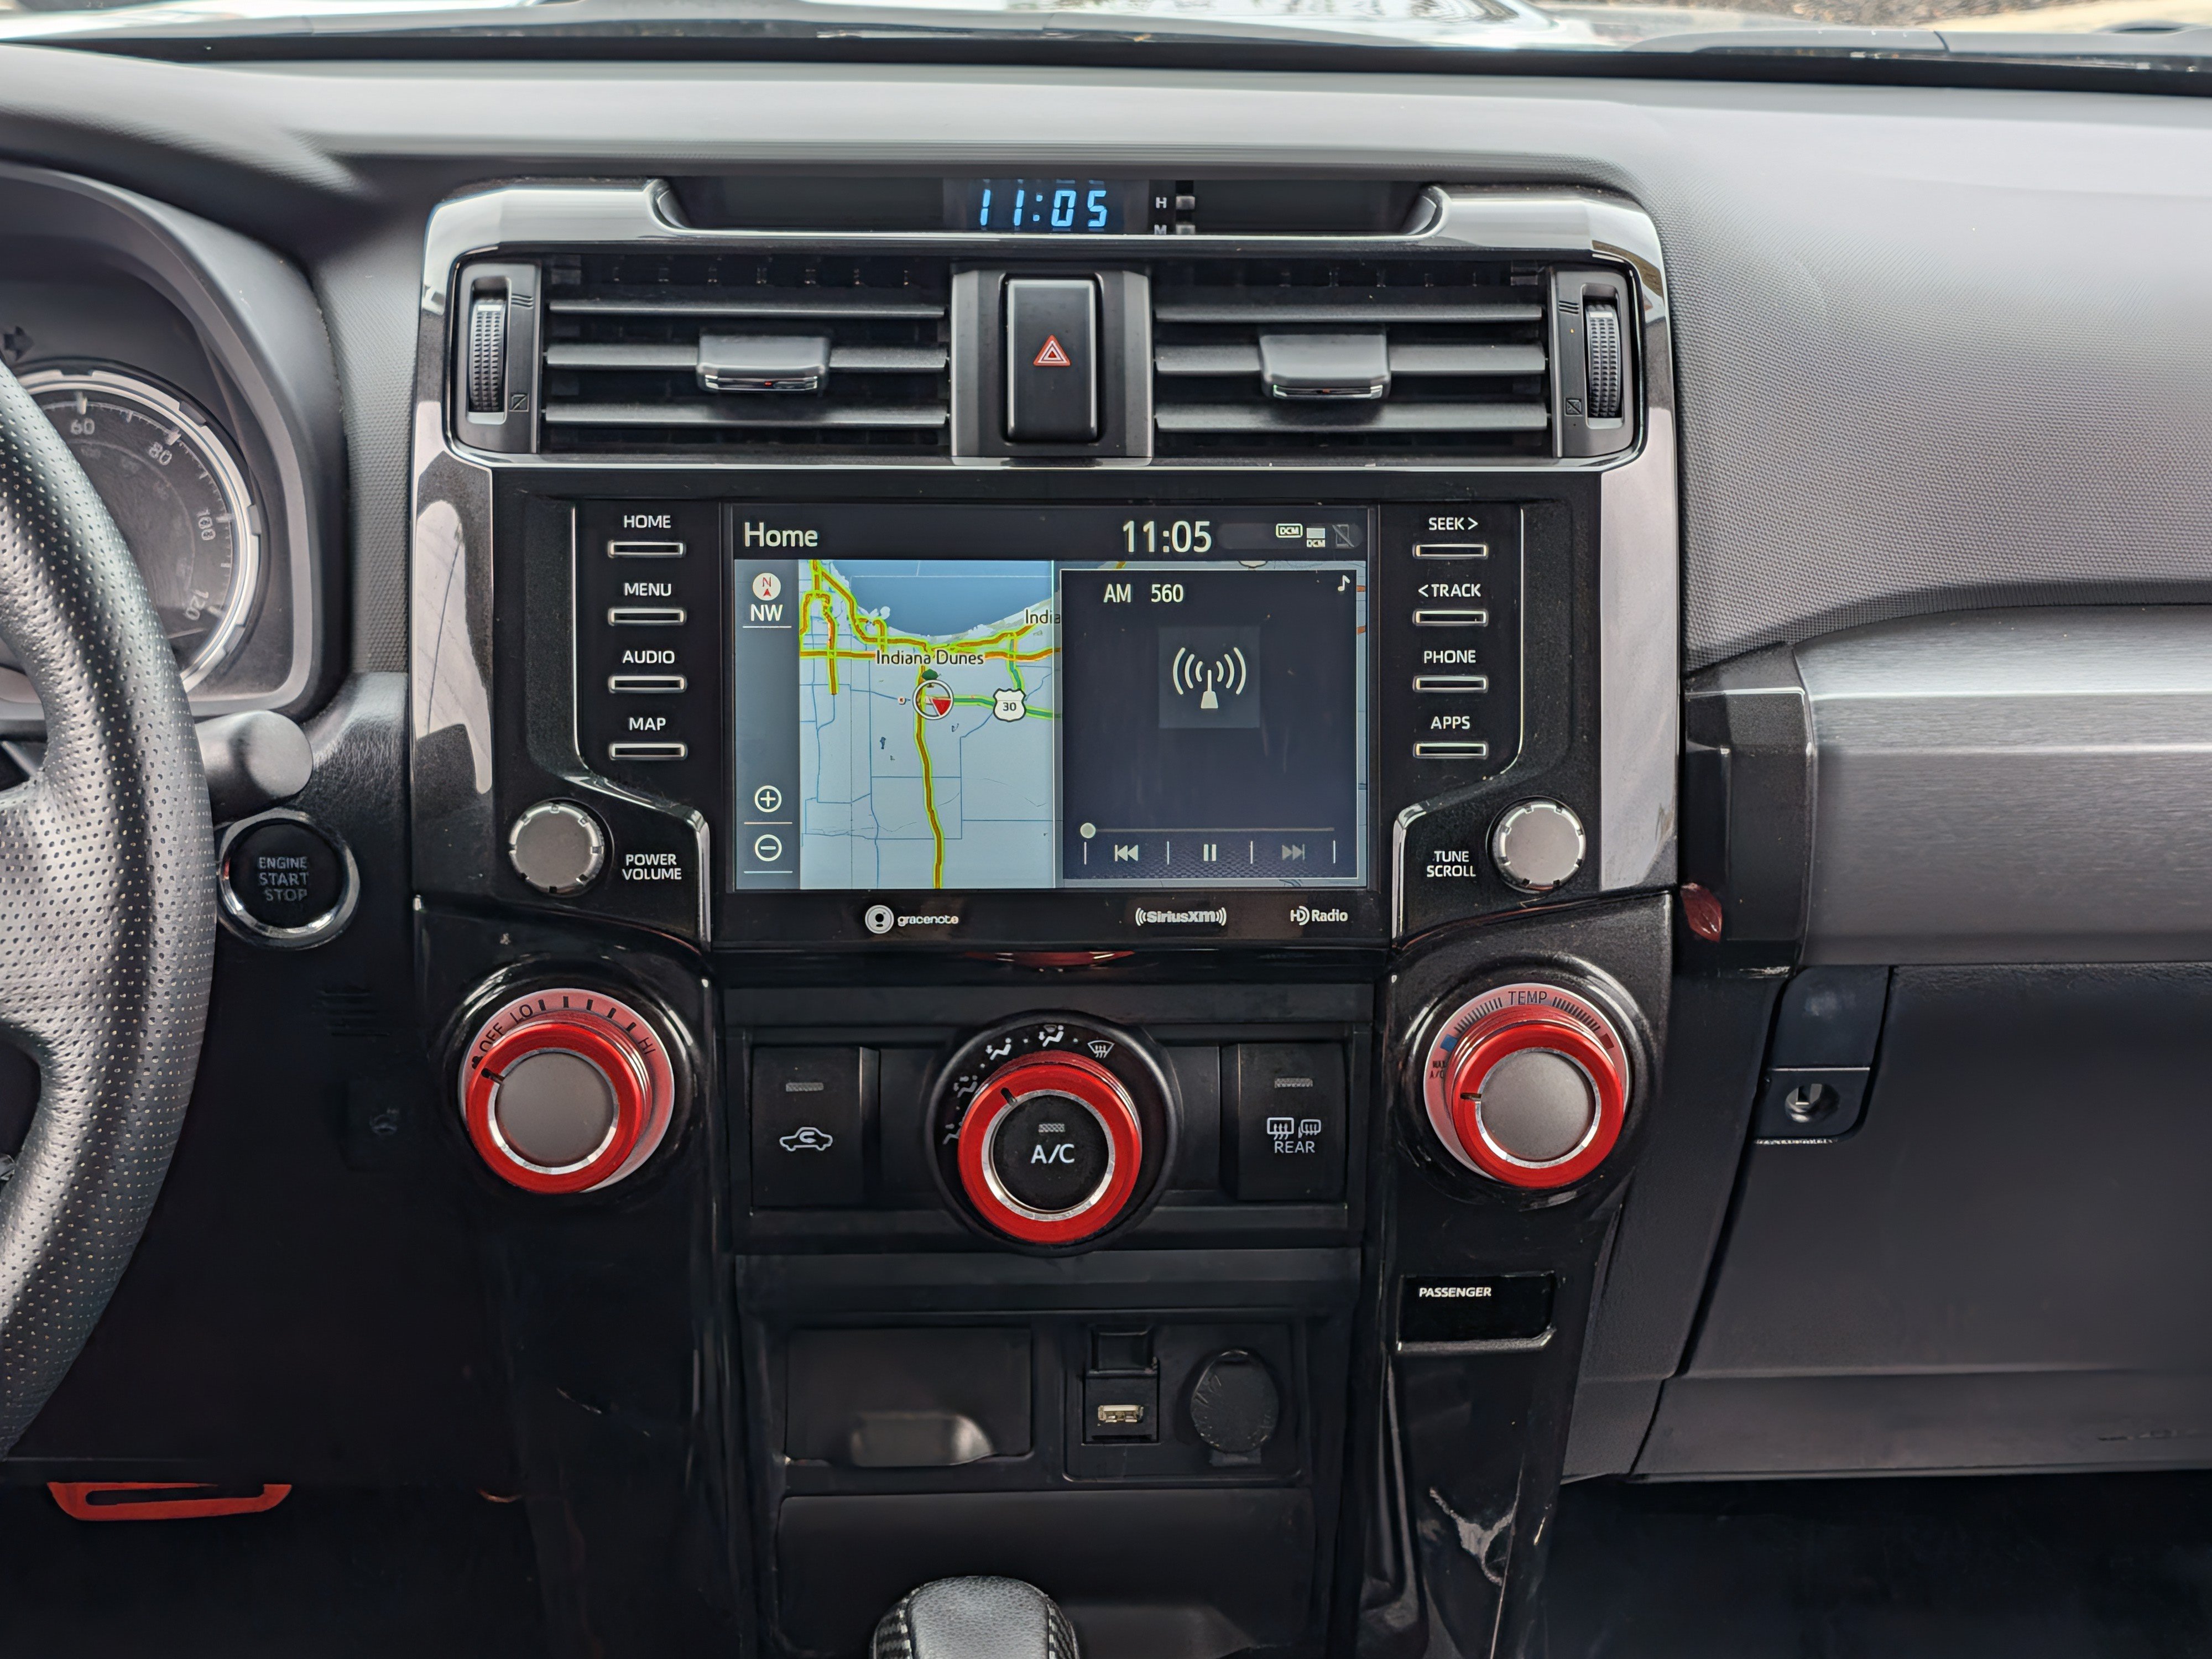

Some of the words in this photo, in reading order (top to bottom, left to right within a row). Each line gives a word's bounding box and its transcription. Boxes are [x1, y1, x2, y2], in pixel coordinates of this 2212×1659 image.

[980, 189, 1107, 227] 11:05
[1156, 197, 1167, 208] H
[1154, 225, 1167, 235] M
[70, 419, 95, 435] 60
[148, 442, 173, 465] 80
[624, 515, 671, 529] HOME
[744, 521, 819, 547] Home
[1123, 520, 1212, 553] 11:05
[762, 577, 771, 587] N
[624, 583, 671, 596] MENU
[1103, 584, 1131, 603] AM
[1151, 584, 1185, 603] 560
[750, 604, 783, 622] NW
[622, 650, 675, 664] AUDIO
[877, 650, 931, 665] Indiana
[936, 650, 984, 665] Dunes
[1423, 650, 1477, 664] PHONE
[1003, 702, 1017, 711] 30
[629, 717, 666, 731] MAP
[1430, 716, 1470, 729] APPS
[258, 856, 308, 869] ENGINE
[625, 853, 677, 866] POWER
[1434, 850, 1469, 863] TUNE
[259, 871, 309, 886] START
[622, 868, 682, 880] VOLUME
[1426, 865, 1477, 878] SCROLL
[264, 888, 308, 902] STOP
[898, 915, 959, 926] gracenote
[1312, 909, 1348, 922] Radio
[1508, 991, 1547, 1004] TEMP
[510, 1004, 534, 1024] LO
[479, 1022, 503, 1053] OFF
[637, 1037, 656, 1055] HI
[1031, 1144, 1075, 1164] A/C
[1274, 1140, 1316, 1154] REAR
[1419, 1287, 1492, 1297] PASSENGER
